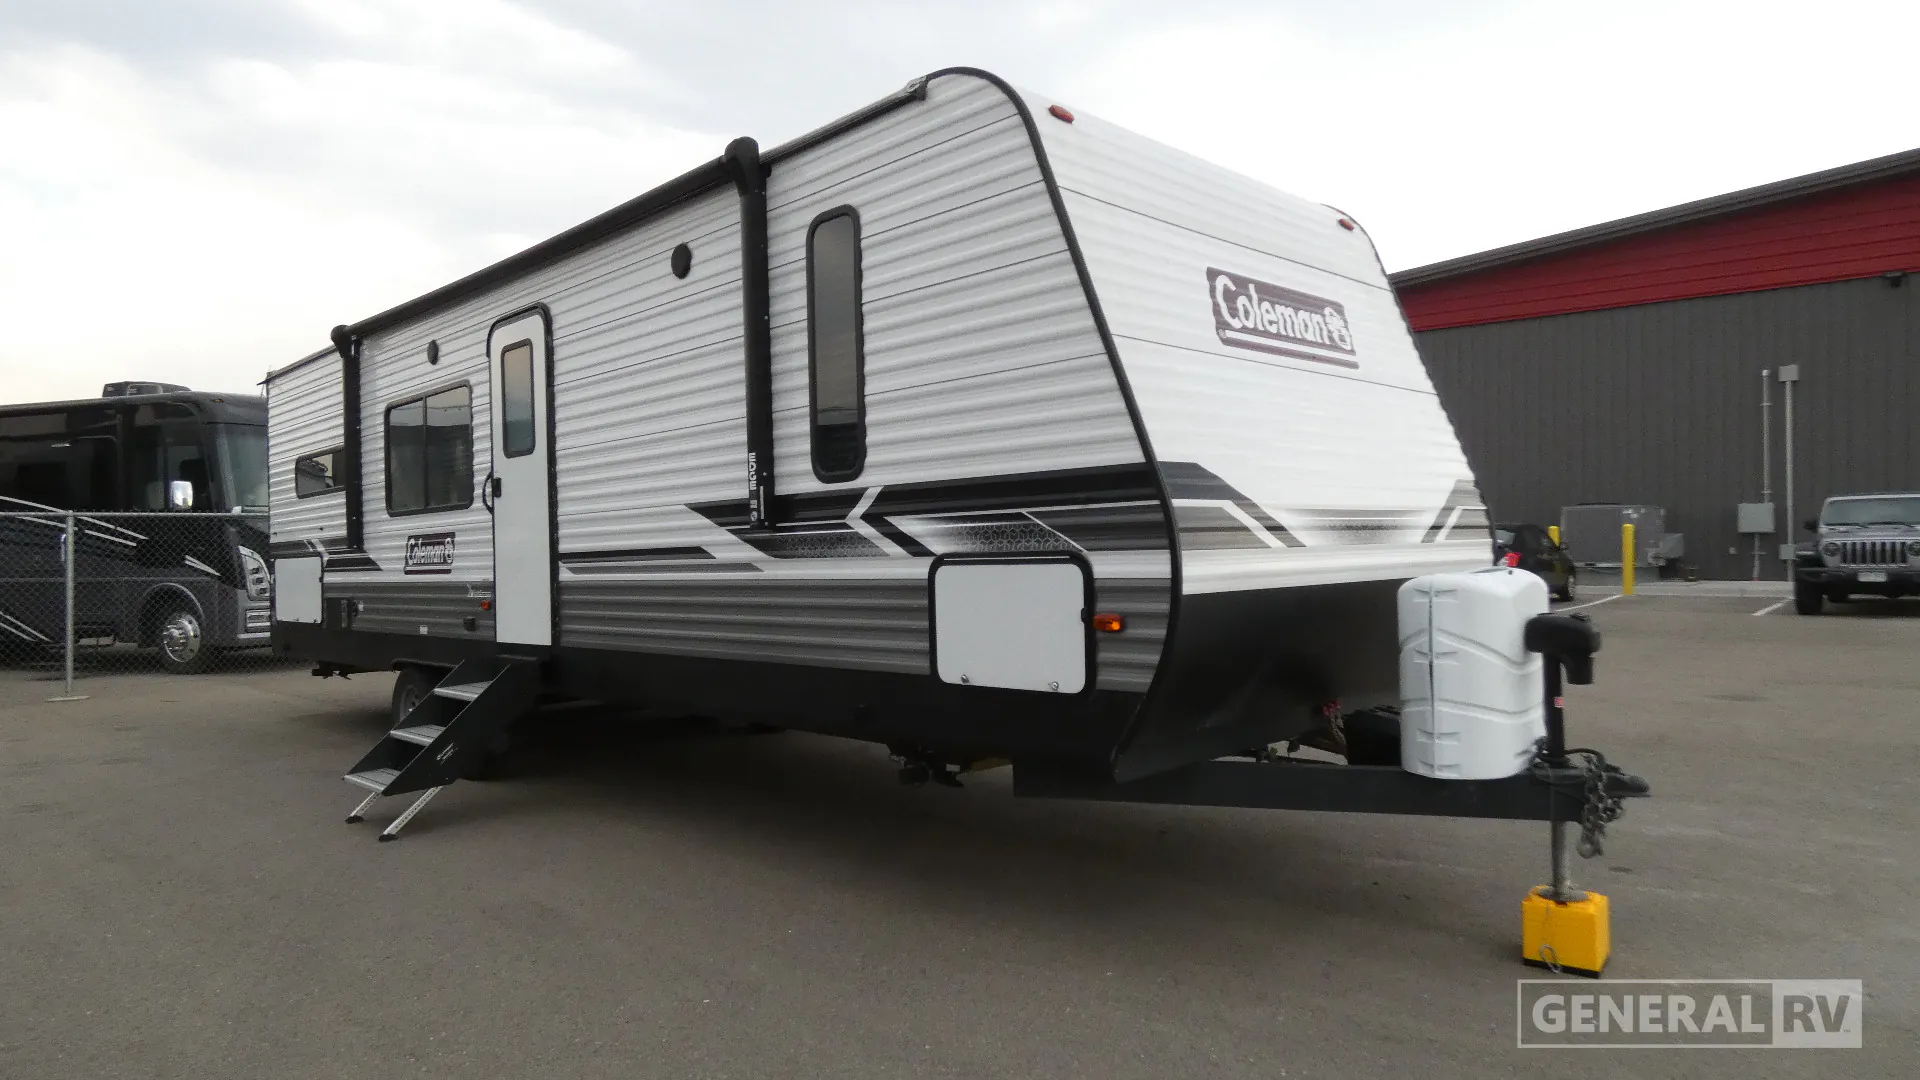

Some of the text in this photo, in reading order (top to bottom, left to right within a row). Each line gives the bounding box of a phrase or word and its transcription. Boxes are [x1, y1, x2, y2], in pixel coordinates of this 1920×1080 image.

[1215, 274, 1332, 345] Coleman
[748, 452, 757, 491] EDGE
[407, 538, 445, 566] Coleman
